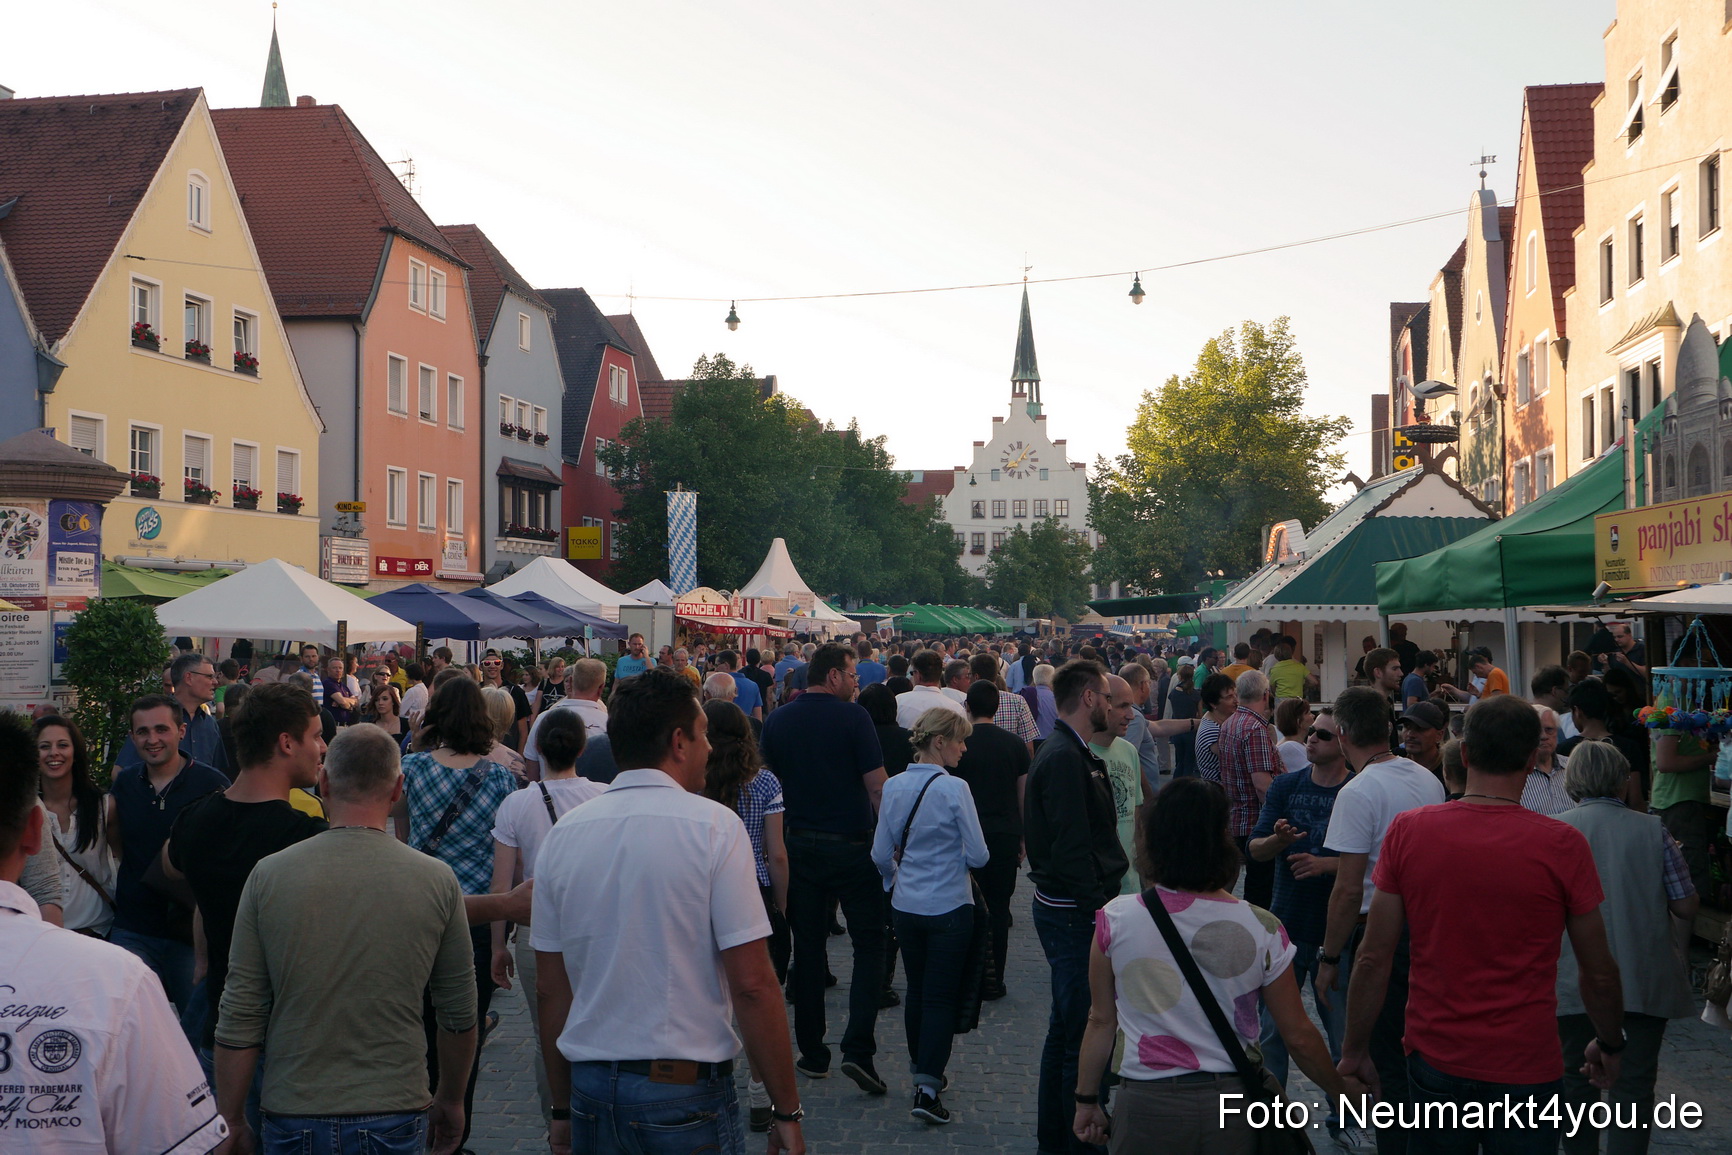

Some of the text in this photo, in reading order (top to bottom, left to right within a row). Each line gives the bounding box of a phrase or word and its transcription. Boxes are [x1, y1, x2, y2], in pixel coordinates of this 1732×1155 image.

[337, 503, 352, 511] KINO
[138, 513, 159, 539] FASS
[1637, 506, 1703, 562] panjabi
[570, 538, 599, 546] TAKKO
[414, 560, 430, 571] DER
[1649, 564, 1687, 583] INDISCHE
[676, 603, 729, 616] MANDELN
[768, 630, 787, 638] POPCORN
[29, 1084, 83, 1094] TRADEMARK
[26, 1093, 81, 1114] Club
[15, 1116, 82, 1129] MONACO
